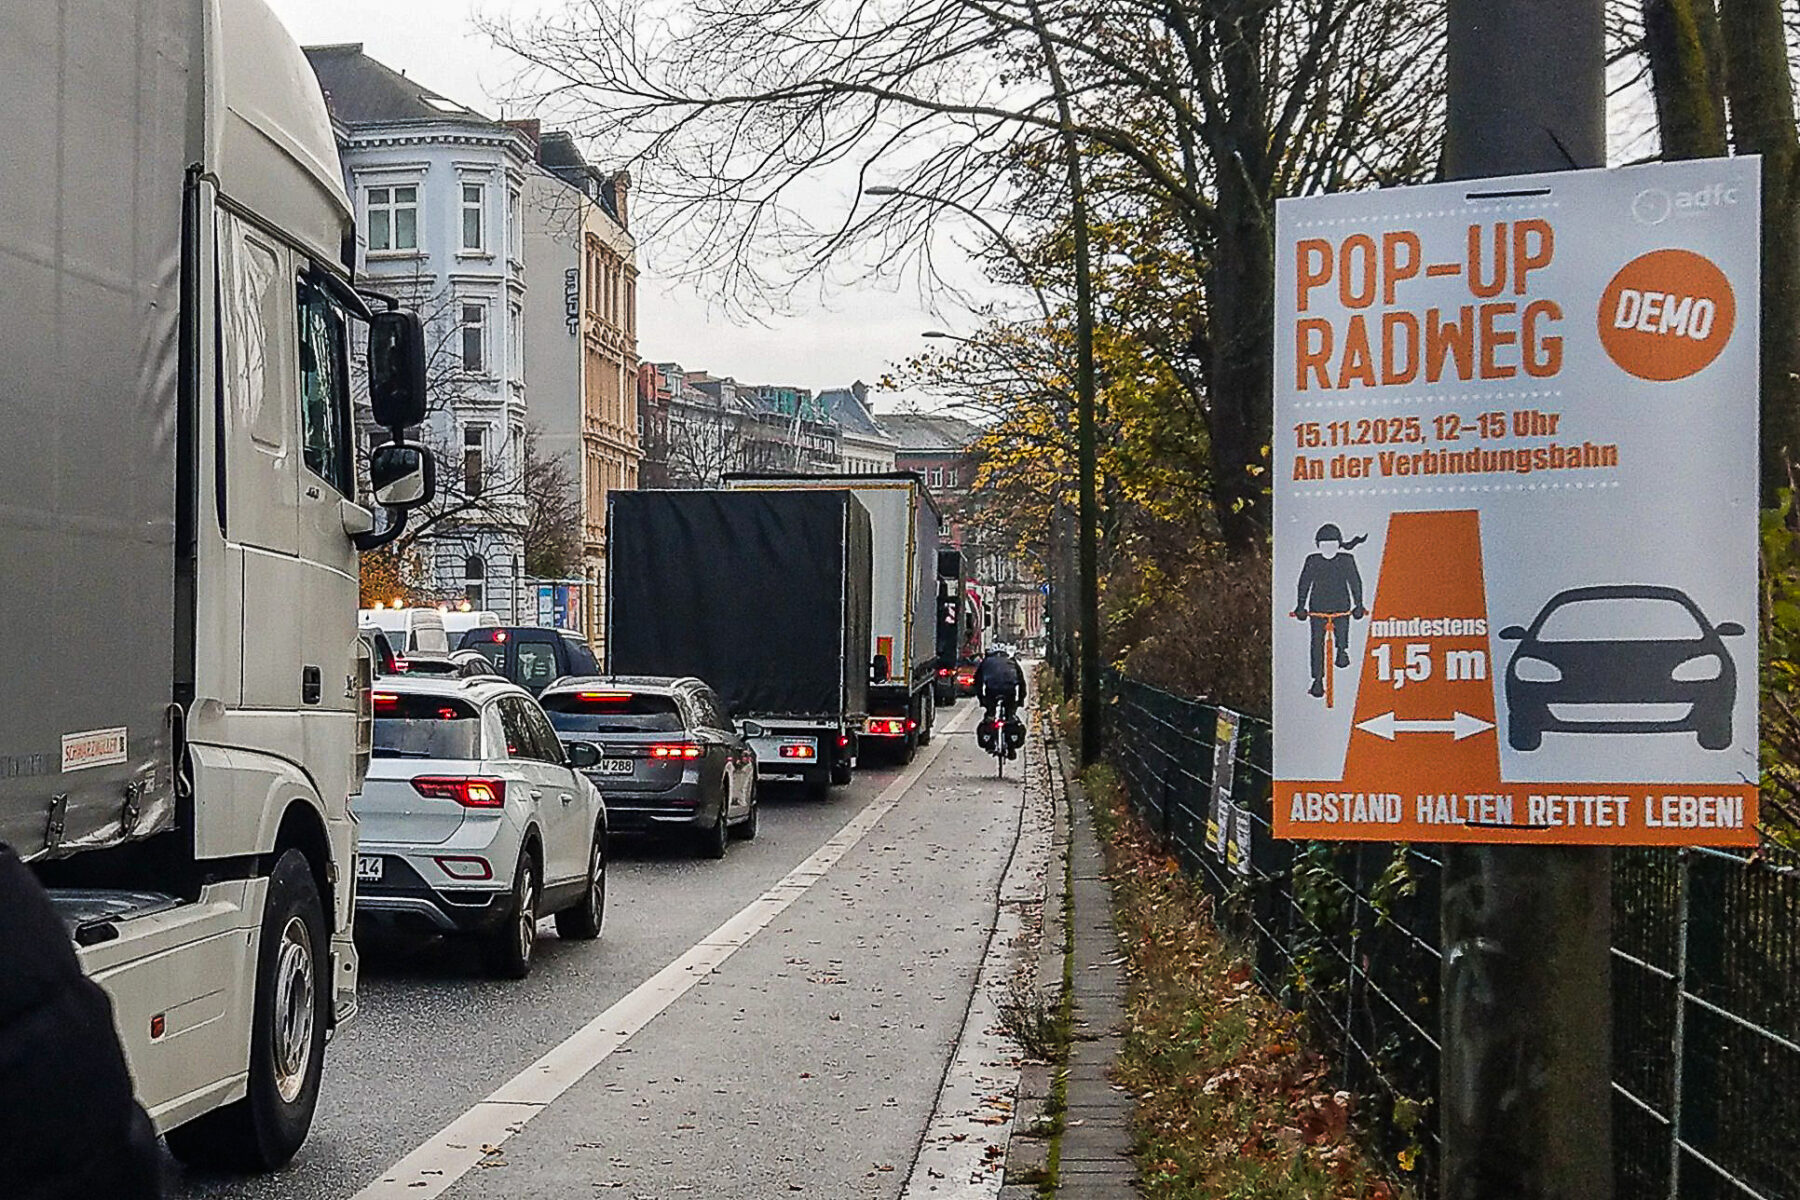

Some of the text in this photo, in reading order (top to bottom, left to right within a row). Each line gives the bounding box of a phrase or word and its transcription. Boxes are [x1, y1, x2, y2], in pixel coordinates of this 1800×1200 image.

[1296, 219, 1554, 312] POP-UP
[1614, 288, 1716, 340] DEMO
[1296, 299, 1564, 391] RADWEG
[1294, 418, 1428, 450] 15.11.2025,
[1513, 409, 1560, 436] Uhr
[1293, 443, 1618, 483] An der Verbindungsbahn
[1371, 616, 1487, 637] mindestens
[1370, 643, 1486, 689] 1,5 m
[611, 760, 632, 771] 288
[1289, 792, 1744, 828] ABSTAND HALTEN RETTET LEBEN!
